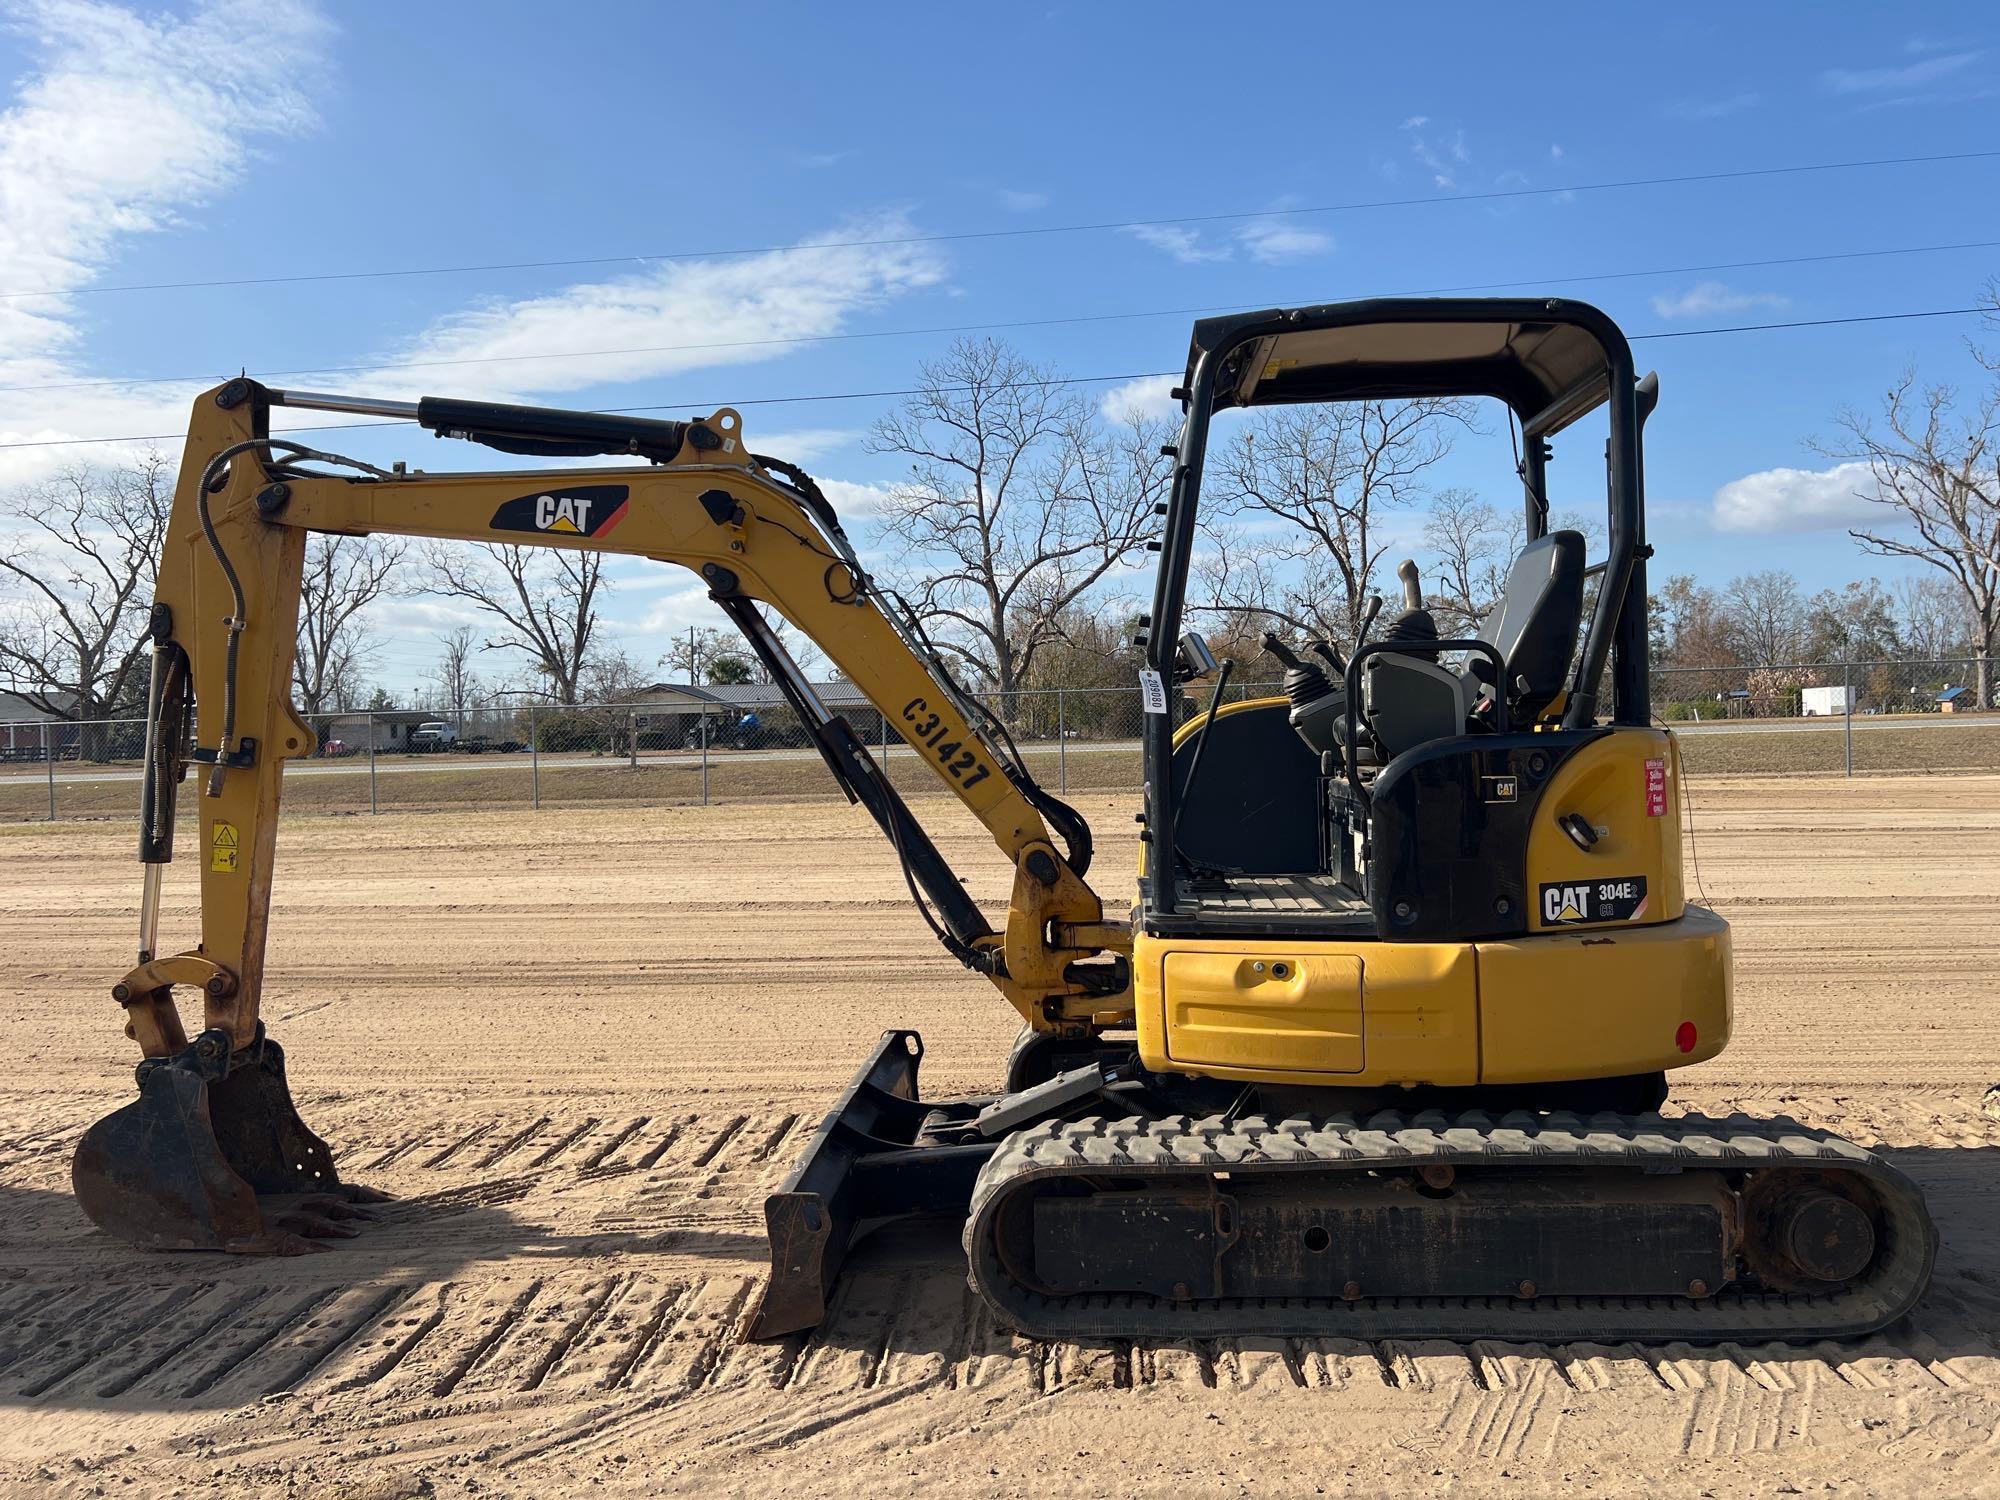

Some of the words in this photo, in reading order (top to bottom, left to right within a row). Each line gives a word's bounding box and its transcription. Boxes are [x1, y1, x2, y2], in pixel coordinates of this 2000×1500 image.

[535, 495, 592, 533] CAT
[1148, 679, 1162, 708] 209080
[903, 698, 990, 789] C31427
[1497, 783, 1514, 796] CAT
[1544, 886, 1590, 921] CAT
[1600, 904, 1614, 917] CR
